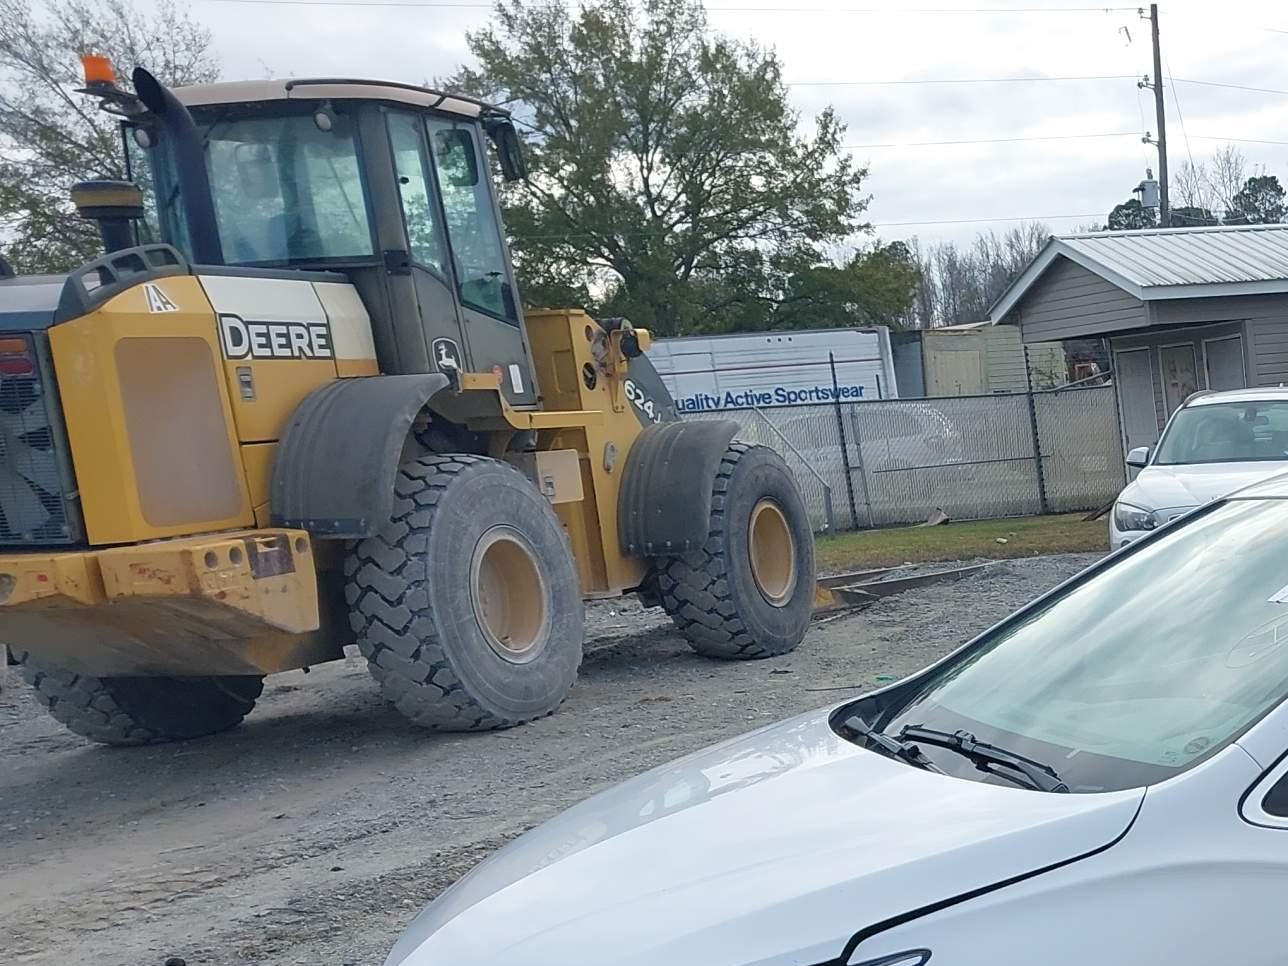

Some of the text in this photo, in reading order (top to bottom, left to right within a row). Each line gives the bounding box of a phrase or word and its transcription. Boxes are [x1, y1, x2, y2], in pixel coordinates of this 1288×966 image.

[221, 314, 332, 358] DEERE
[675, 384, 865, 411] uality Active Sportswear
